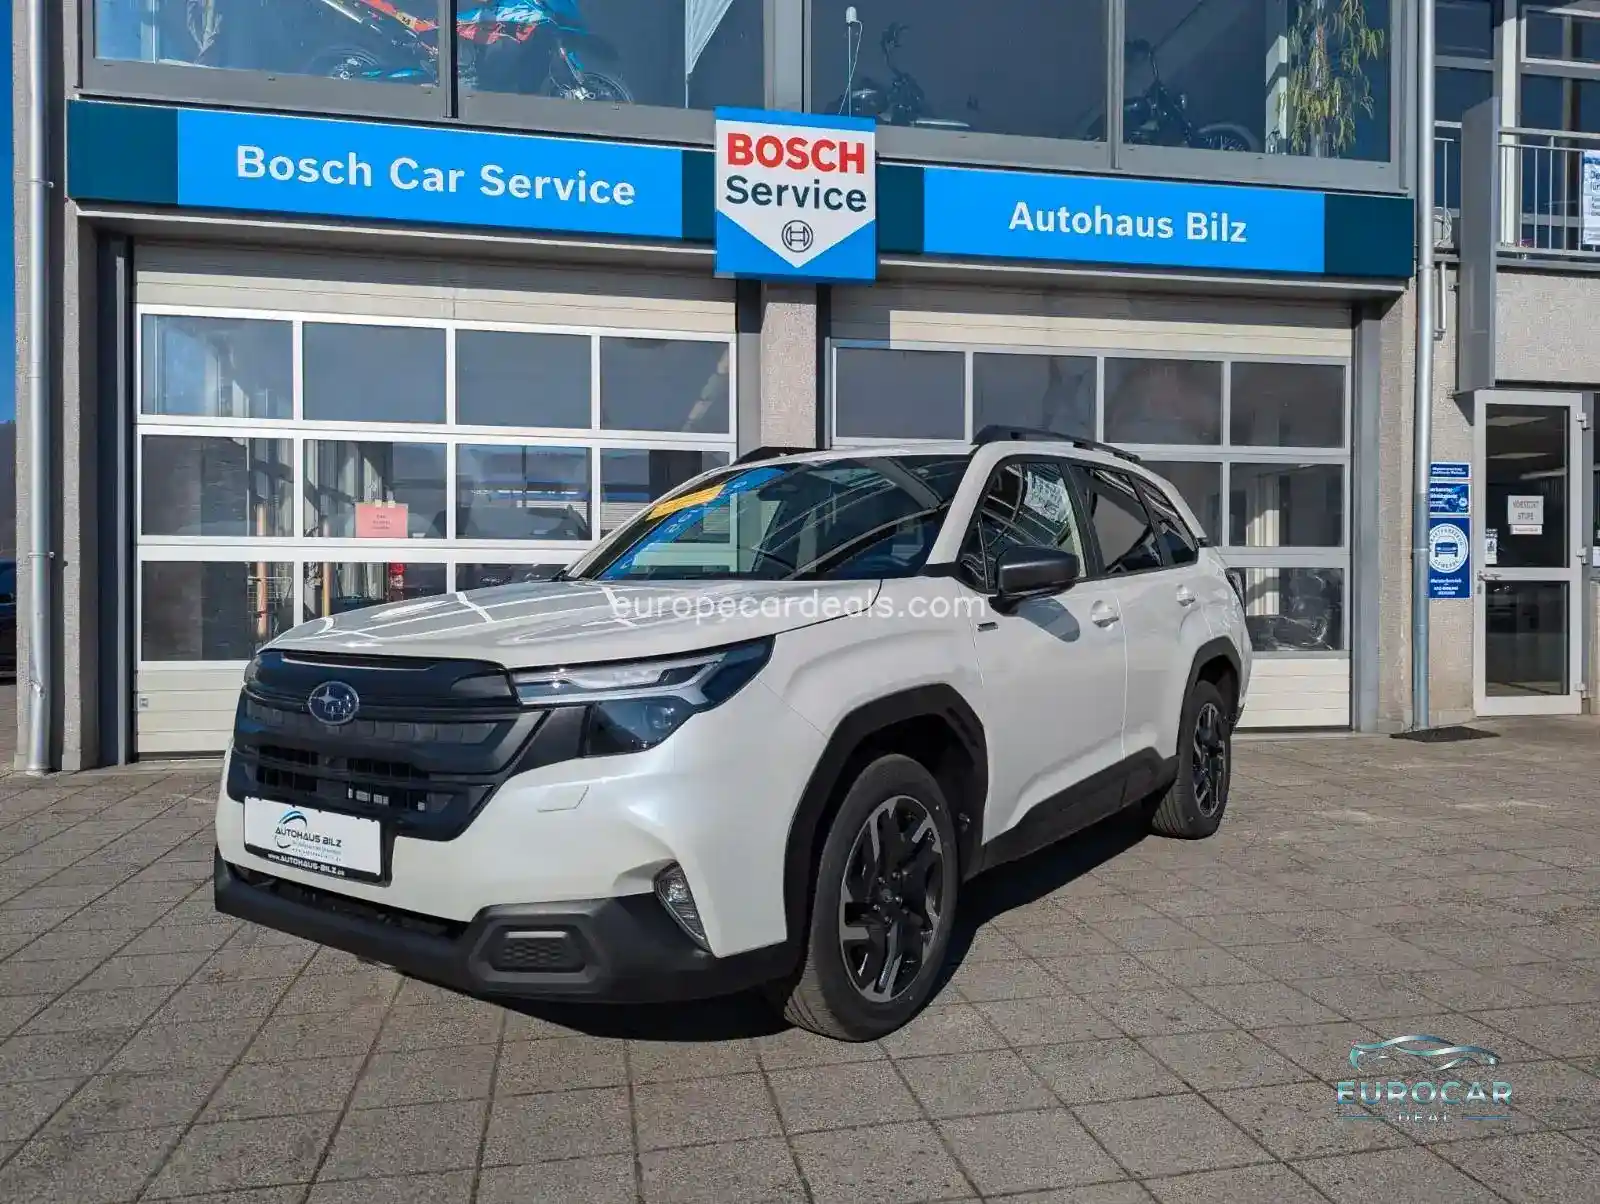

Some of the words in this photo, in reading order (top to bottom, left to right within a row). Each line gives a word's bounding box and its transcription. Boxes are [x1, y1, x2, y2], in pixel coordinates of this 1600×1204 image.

[727, 132, 865, 174] BOSCH
[236, 144, 372, 187] Bosch
[389, 157, 465, 193] Car
[480, 164, 636, 206] Service
[725, 175, 867, 212] Service
[1008, 201, 1173, 239] Autohaus
[1186, 212, 1247, 243] Bilz
[275, 826, 321, 843] AUTOHAUS
[322, 836, 342, 848] BILZ
